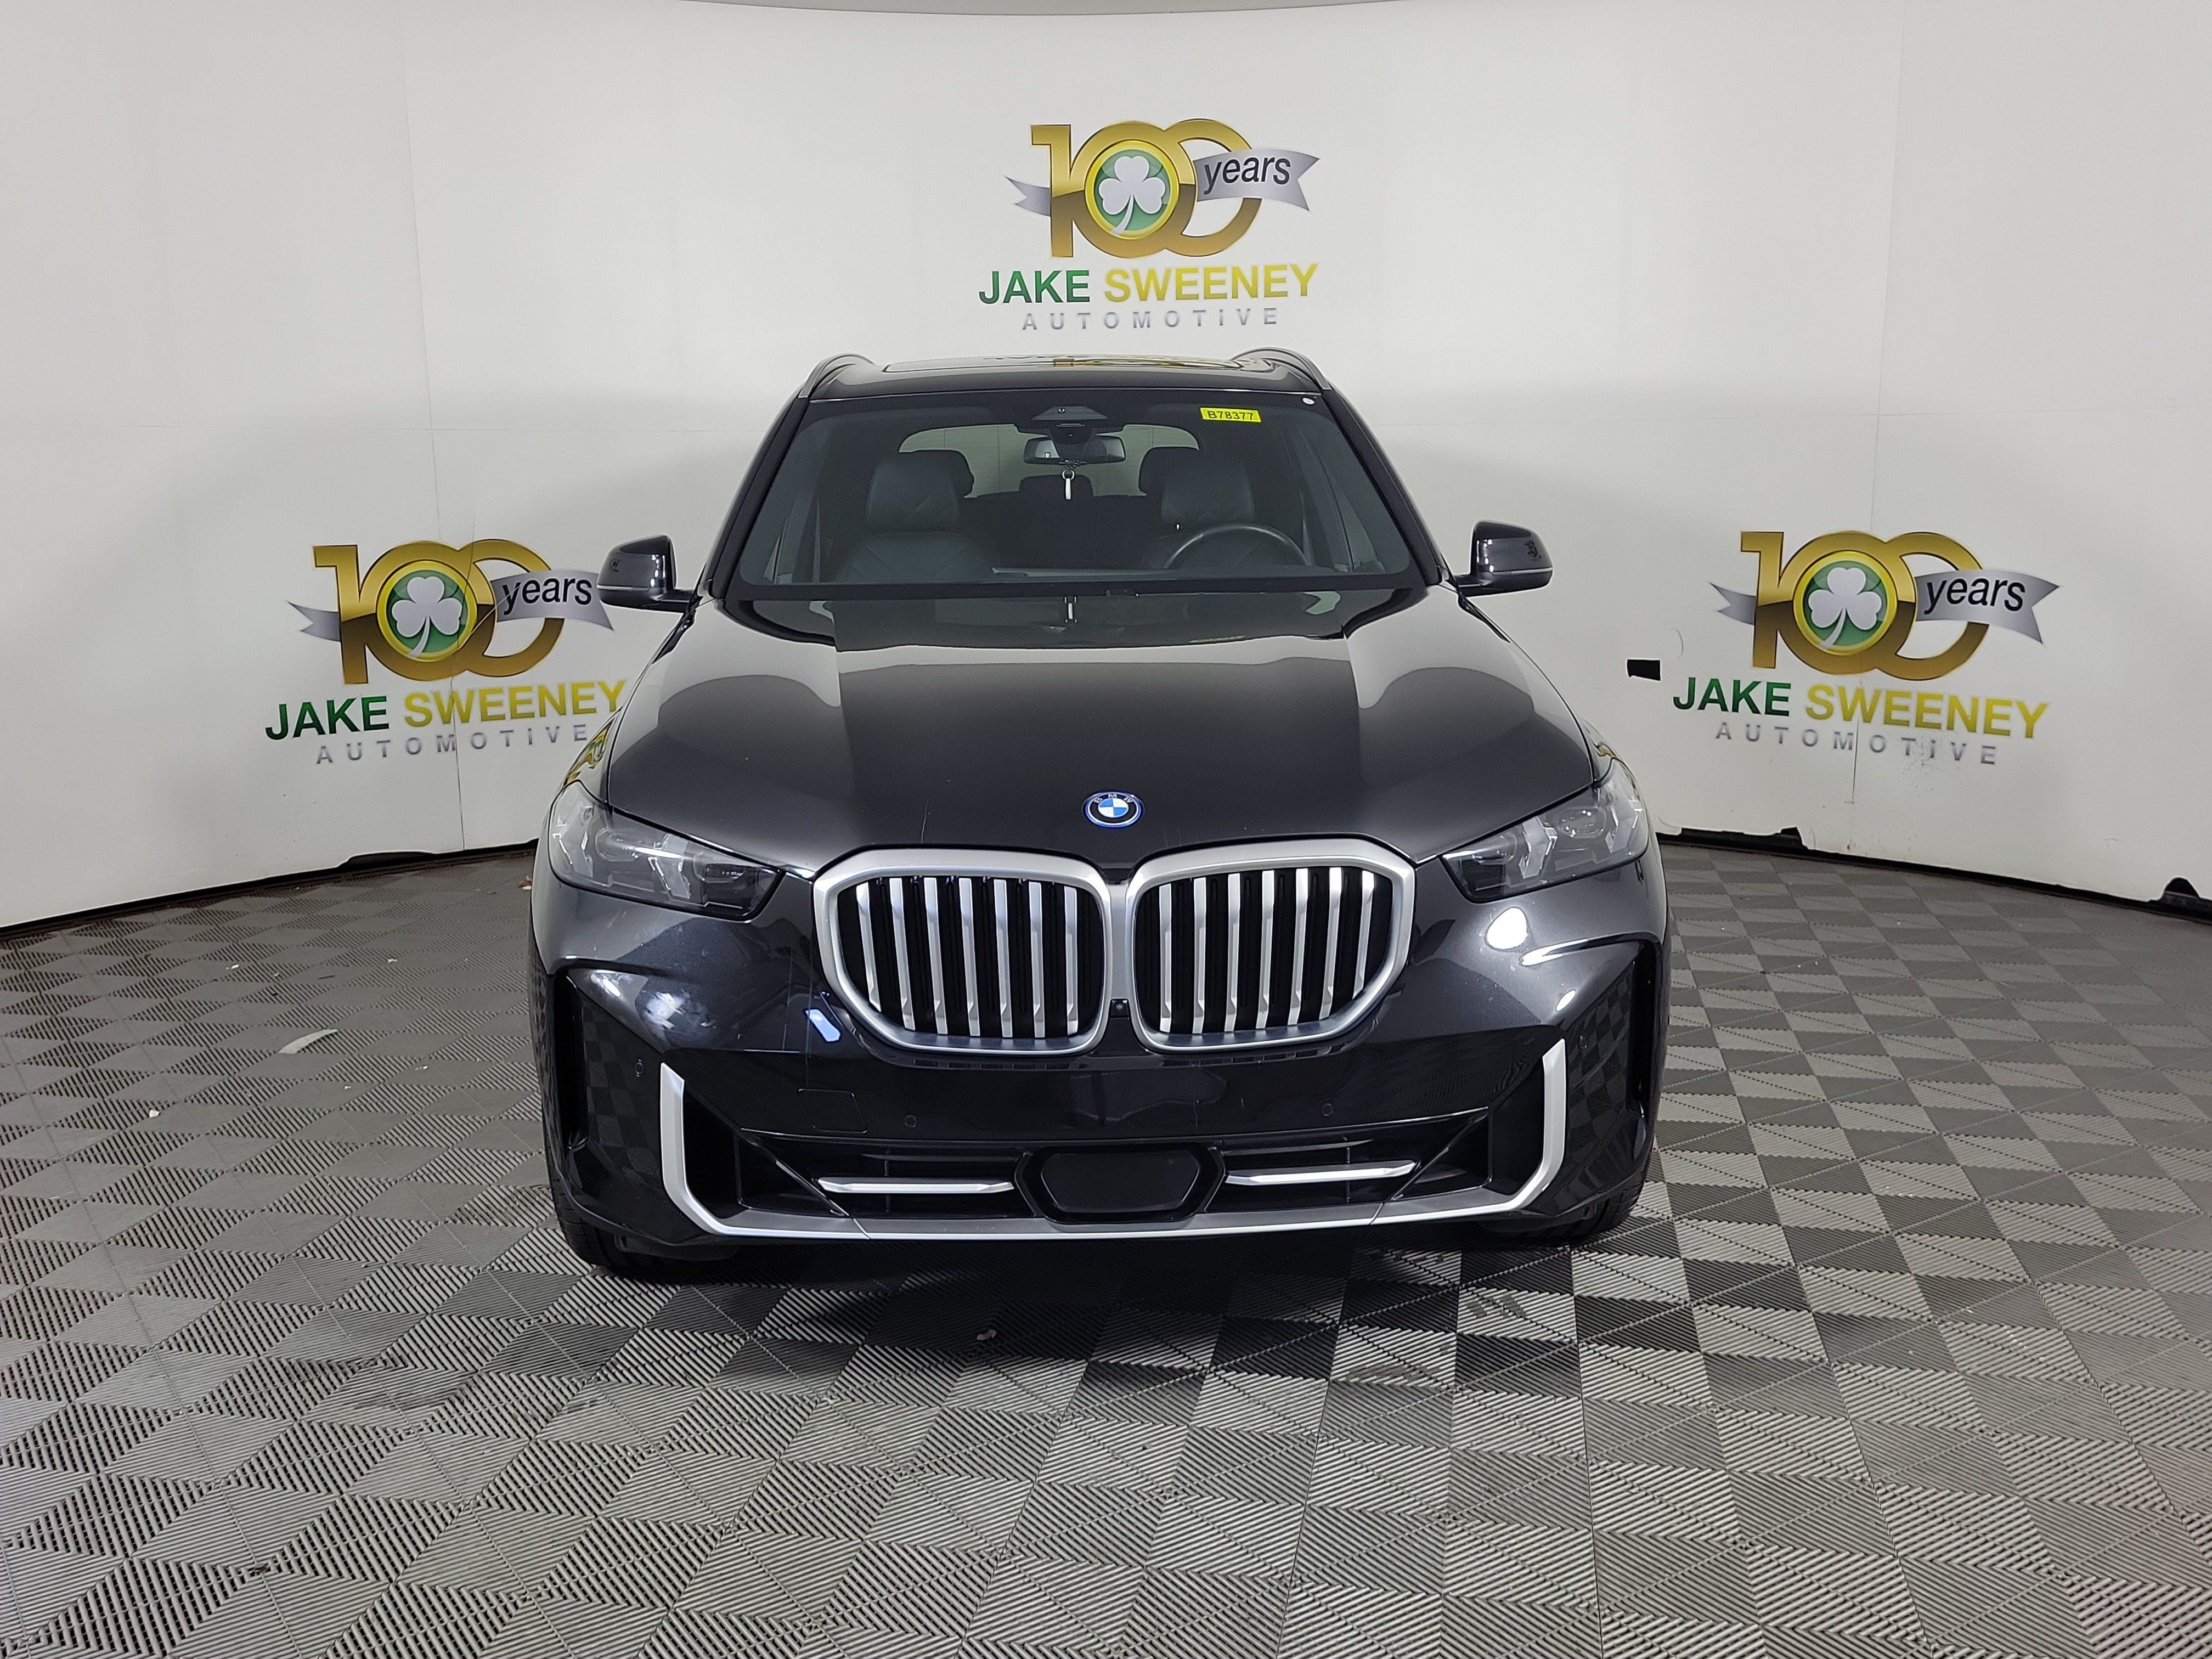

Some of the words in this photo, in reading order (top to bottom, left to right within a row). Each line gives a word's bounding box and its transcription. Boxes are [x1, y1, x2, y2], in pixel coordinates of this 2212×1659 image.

[1030, 118, 1262, 258] 100
[1203, 156, 1291, 195] years
[978, 269, 1091, 304] JAKE
[1104, 263, 1319, 302] SWEENEY
[1022, 307, 1277, 330] AUTOMOTIVE
[1207, 411, 1254, 420] B78377
[312, 539, 565, 685] 100
[502, 577, 593, 616] years
[1740, 530, 1990, 681] 100
[1924, 577, 2026, 615] years
[265, 695, 390, 741] JAKE
[404, 680, 627, 728] SWEENEY
[1673, 676, 1792, 717] JAKE
[1805, 684, 2049, 739] SWEENEY
[316, 724, 588, 765] AUTOMOTIVE
[1715, 721, 1997, 765] AUTOMOTIVE
[1093, 794, 1133, 803] BMW
